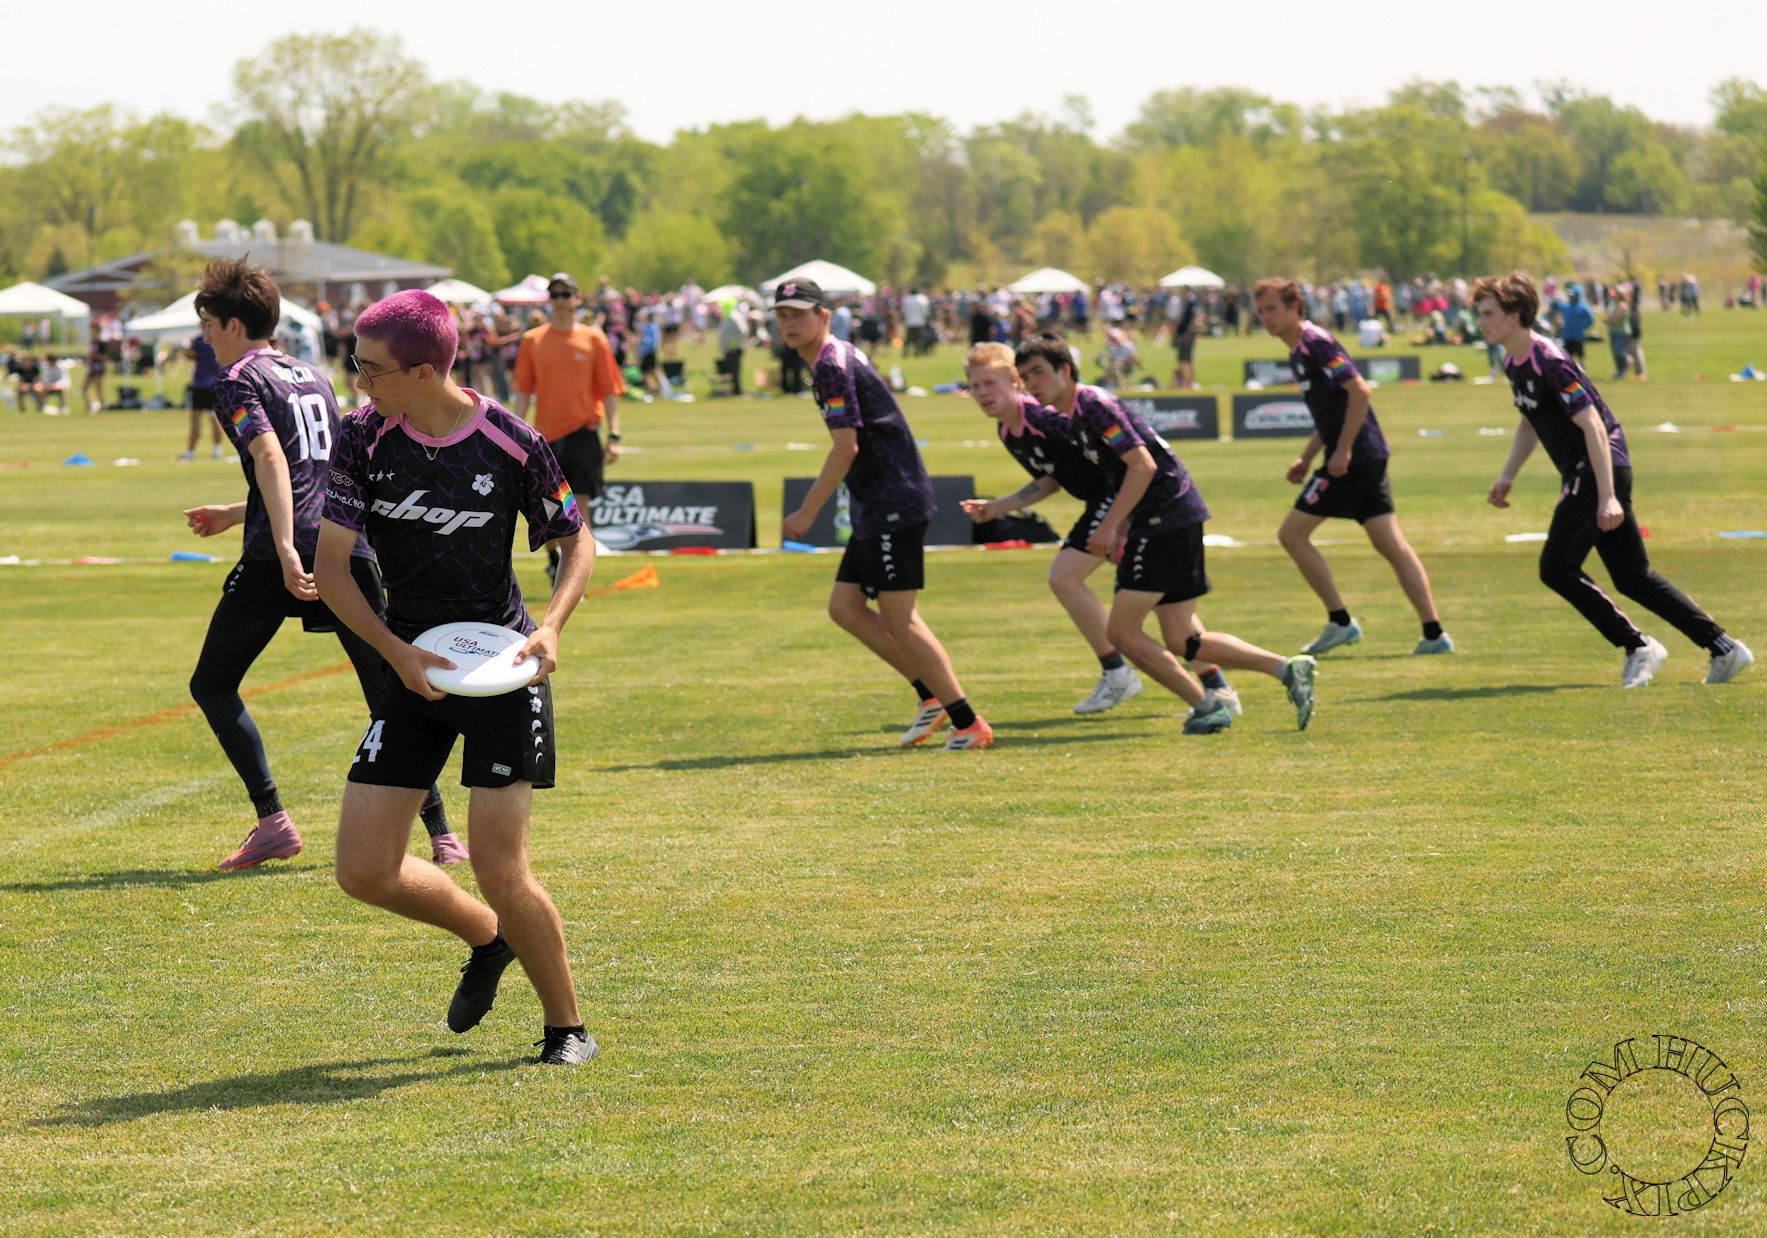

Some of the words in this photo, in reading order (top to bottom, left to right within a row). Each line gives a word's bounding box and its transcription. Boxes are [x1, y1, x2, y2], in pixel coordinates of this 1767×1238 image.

[287, 393, 332, 461] 18
[370, 489, 494, 535] chop
[593, 505, 718, 525] ULTIMATE
[453, 636, 478, 646] USA
